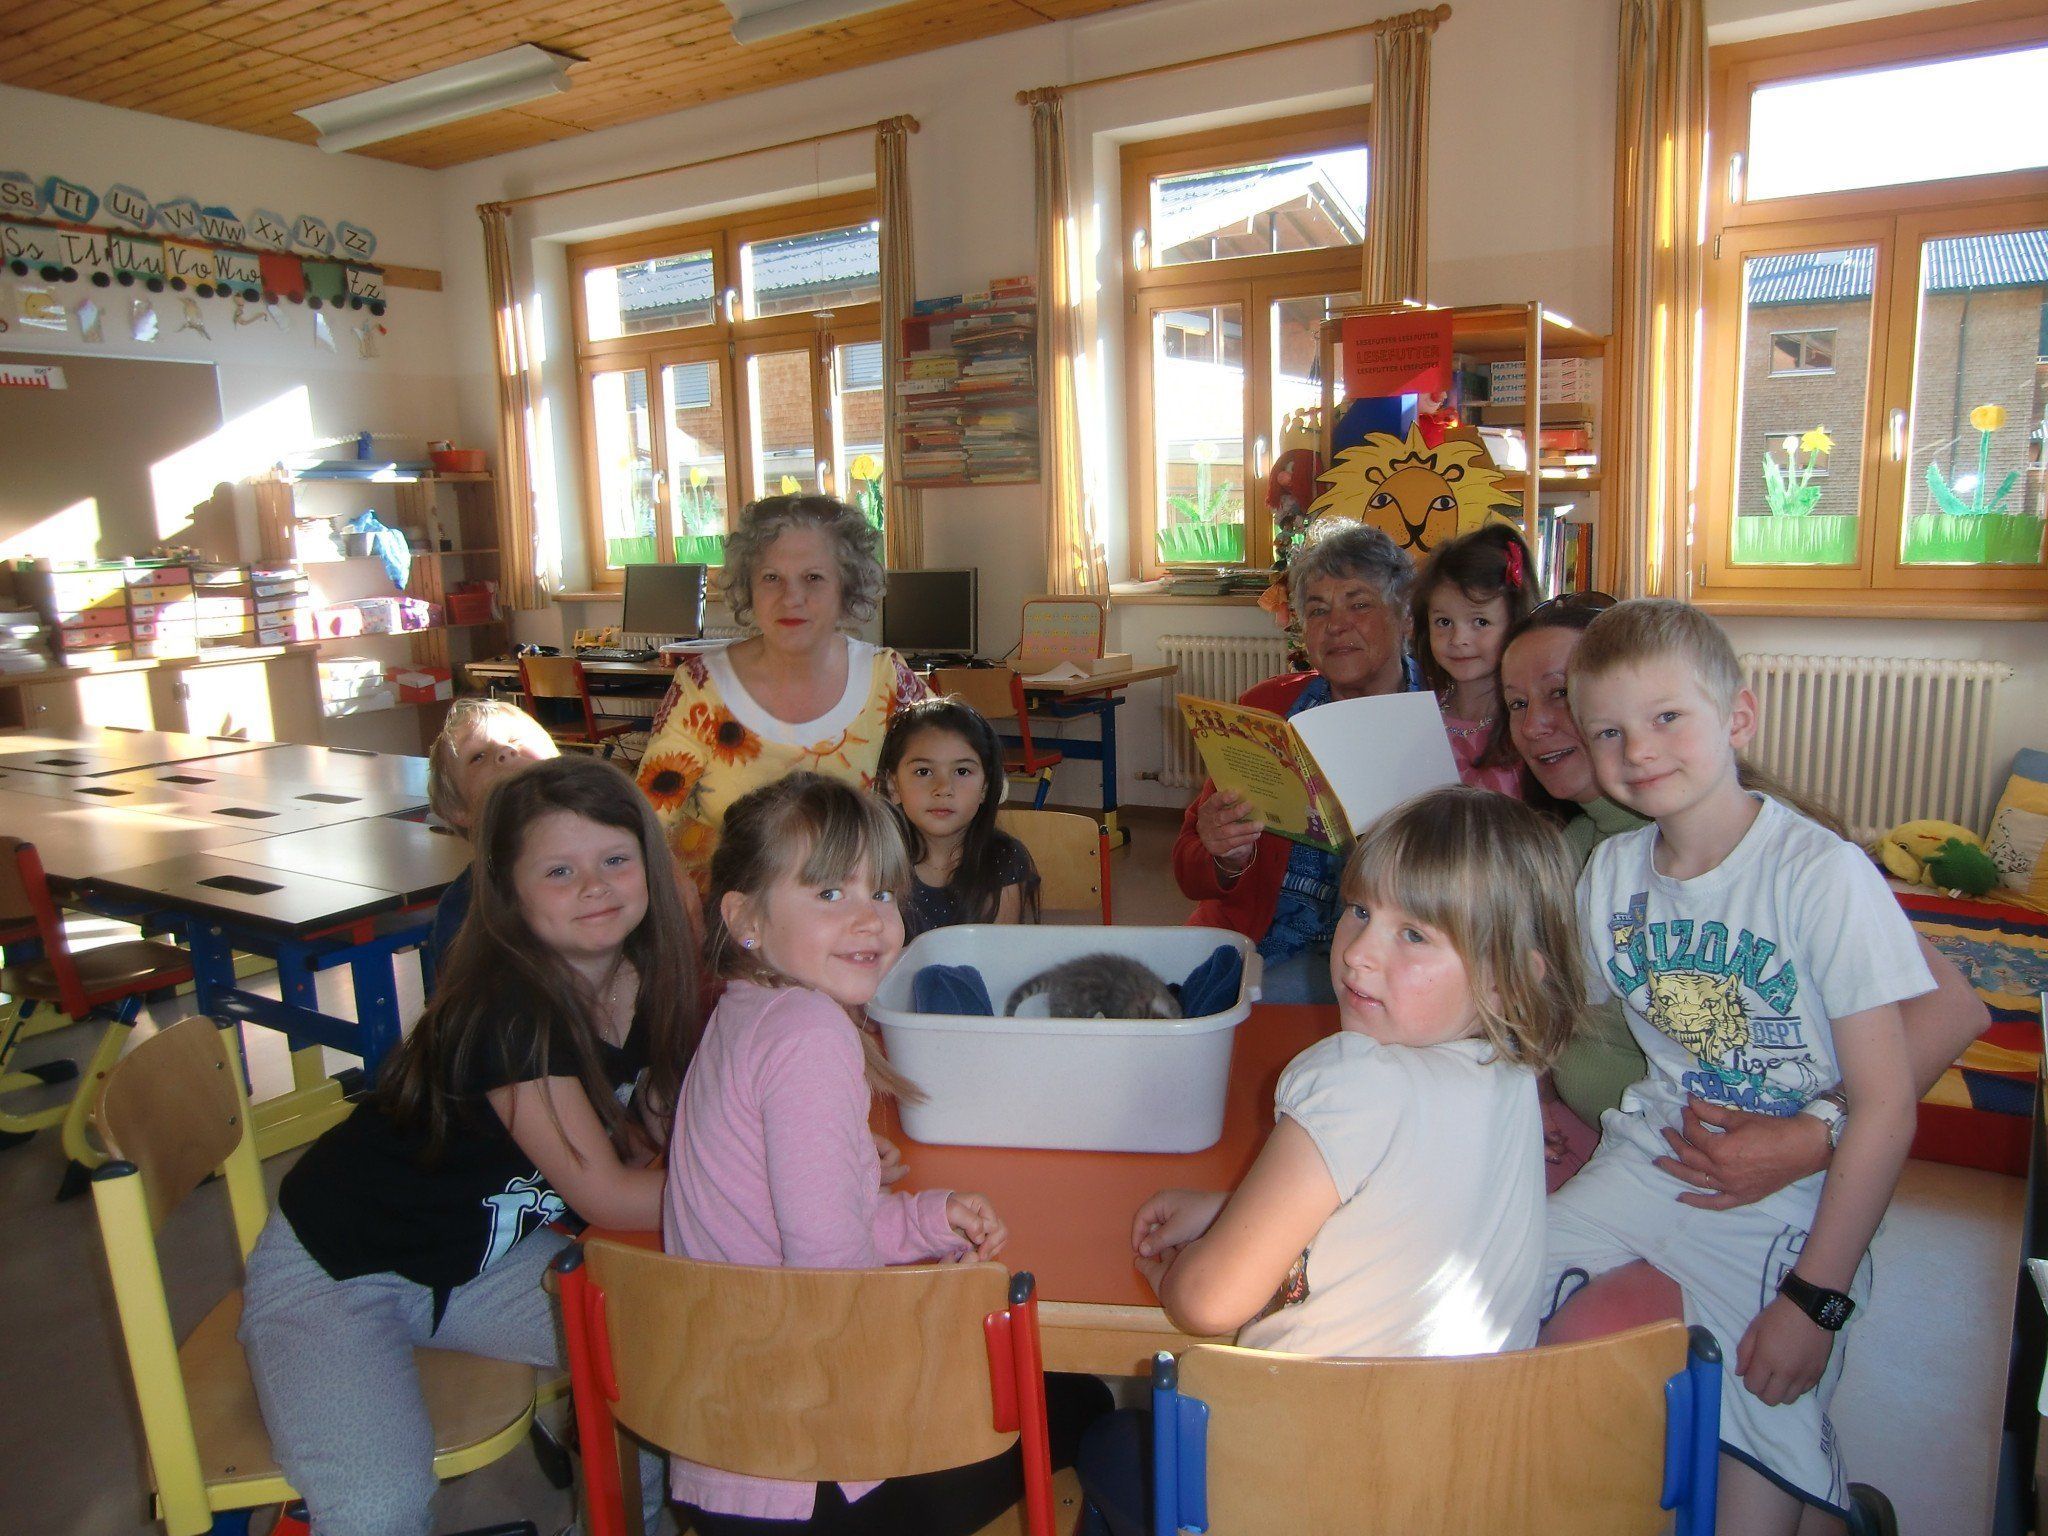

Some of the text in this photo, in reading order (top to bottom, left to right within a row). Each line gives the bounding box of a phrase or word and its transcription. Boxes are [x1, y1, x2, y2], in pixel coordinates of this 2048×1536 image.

[1, 182, 368, 253] Ss Tt Uu Vv Ww Xx Yy Zz
[1751, 1020, 1803, 1045] DEPT
